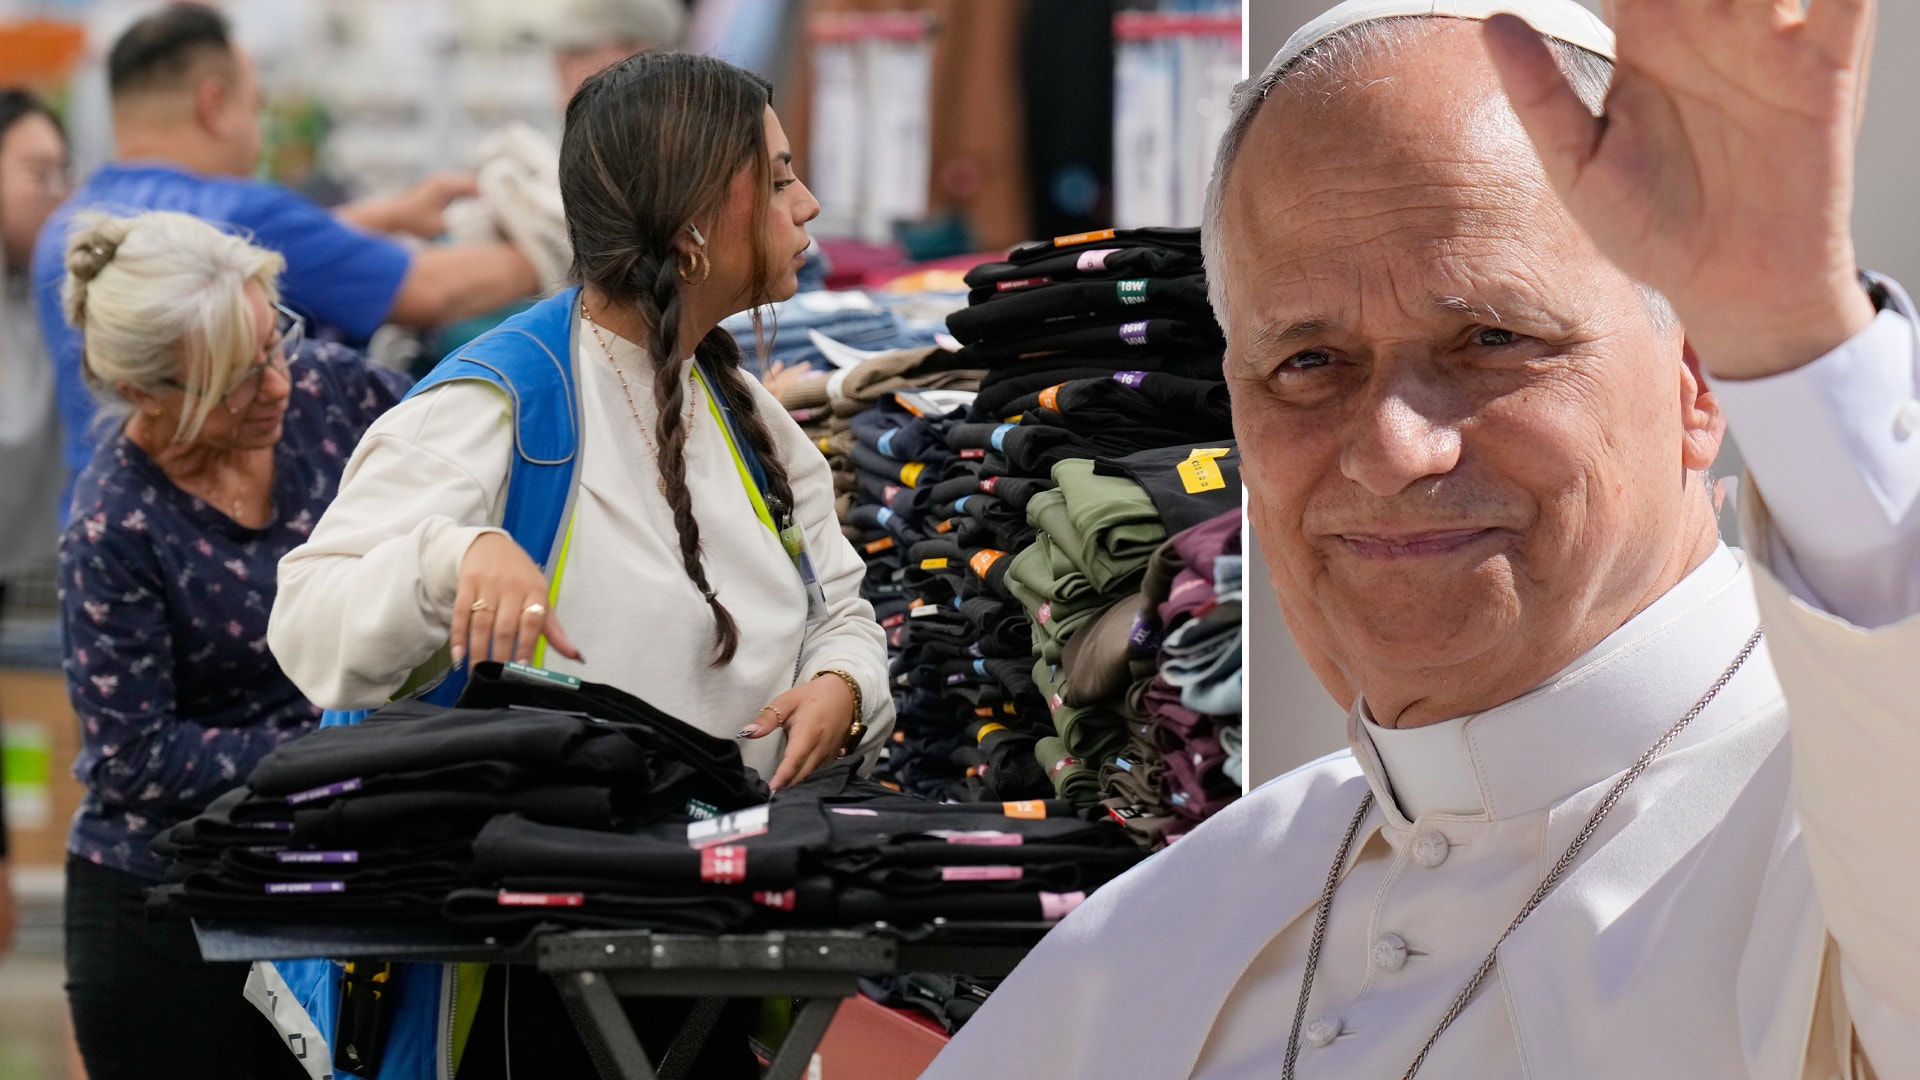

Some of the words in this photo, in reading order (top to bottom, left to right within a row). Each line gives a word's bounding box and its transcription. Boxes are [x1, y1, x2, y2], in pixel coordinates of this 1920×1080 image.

[1121, 280, 1145, 291] 18W
[1122, 322, 1146, 334] 16W
[1121, 374, 1134, 385] 16
